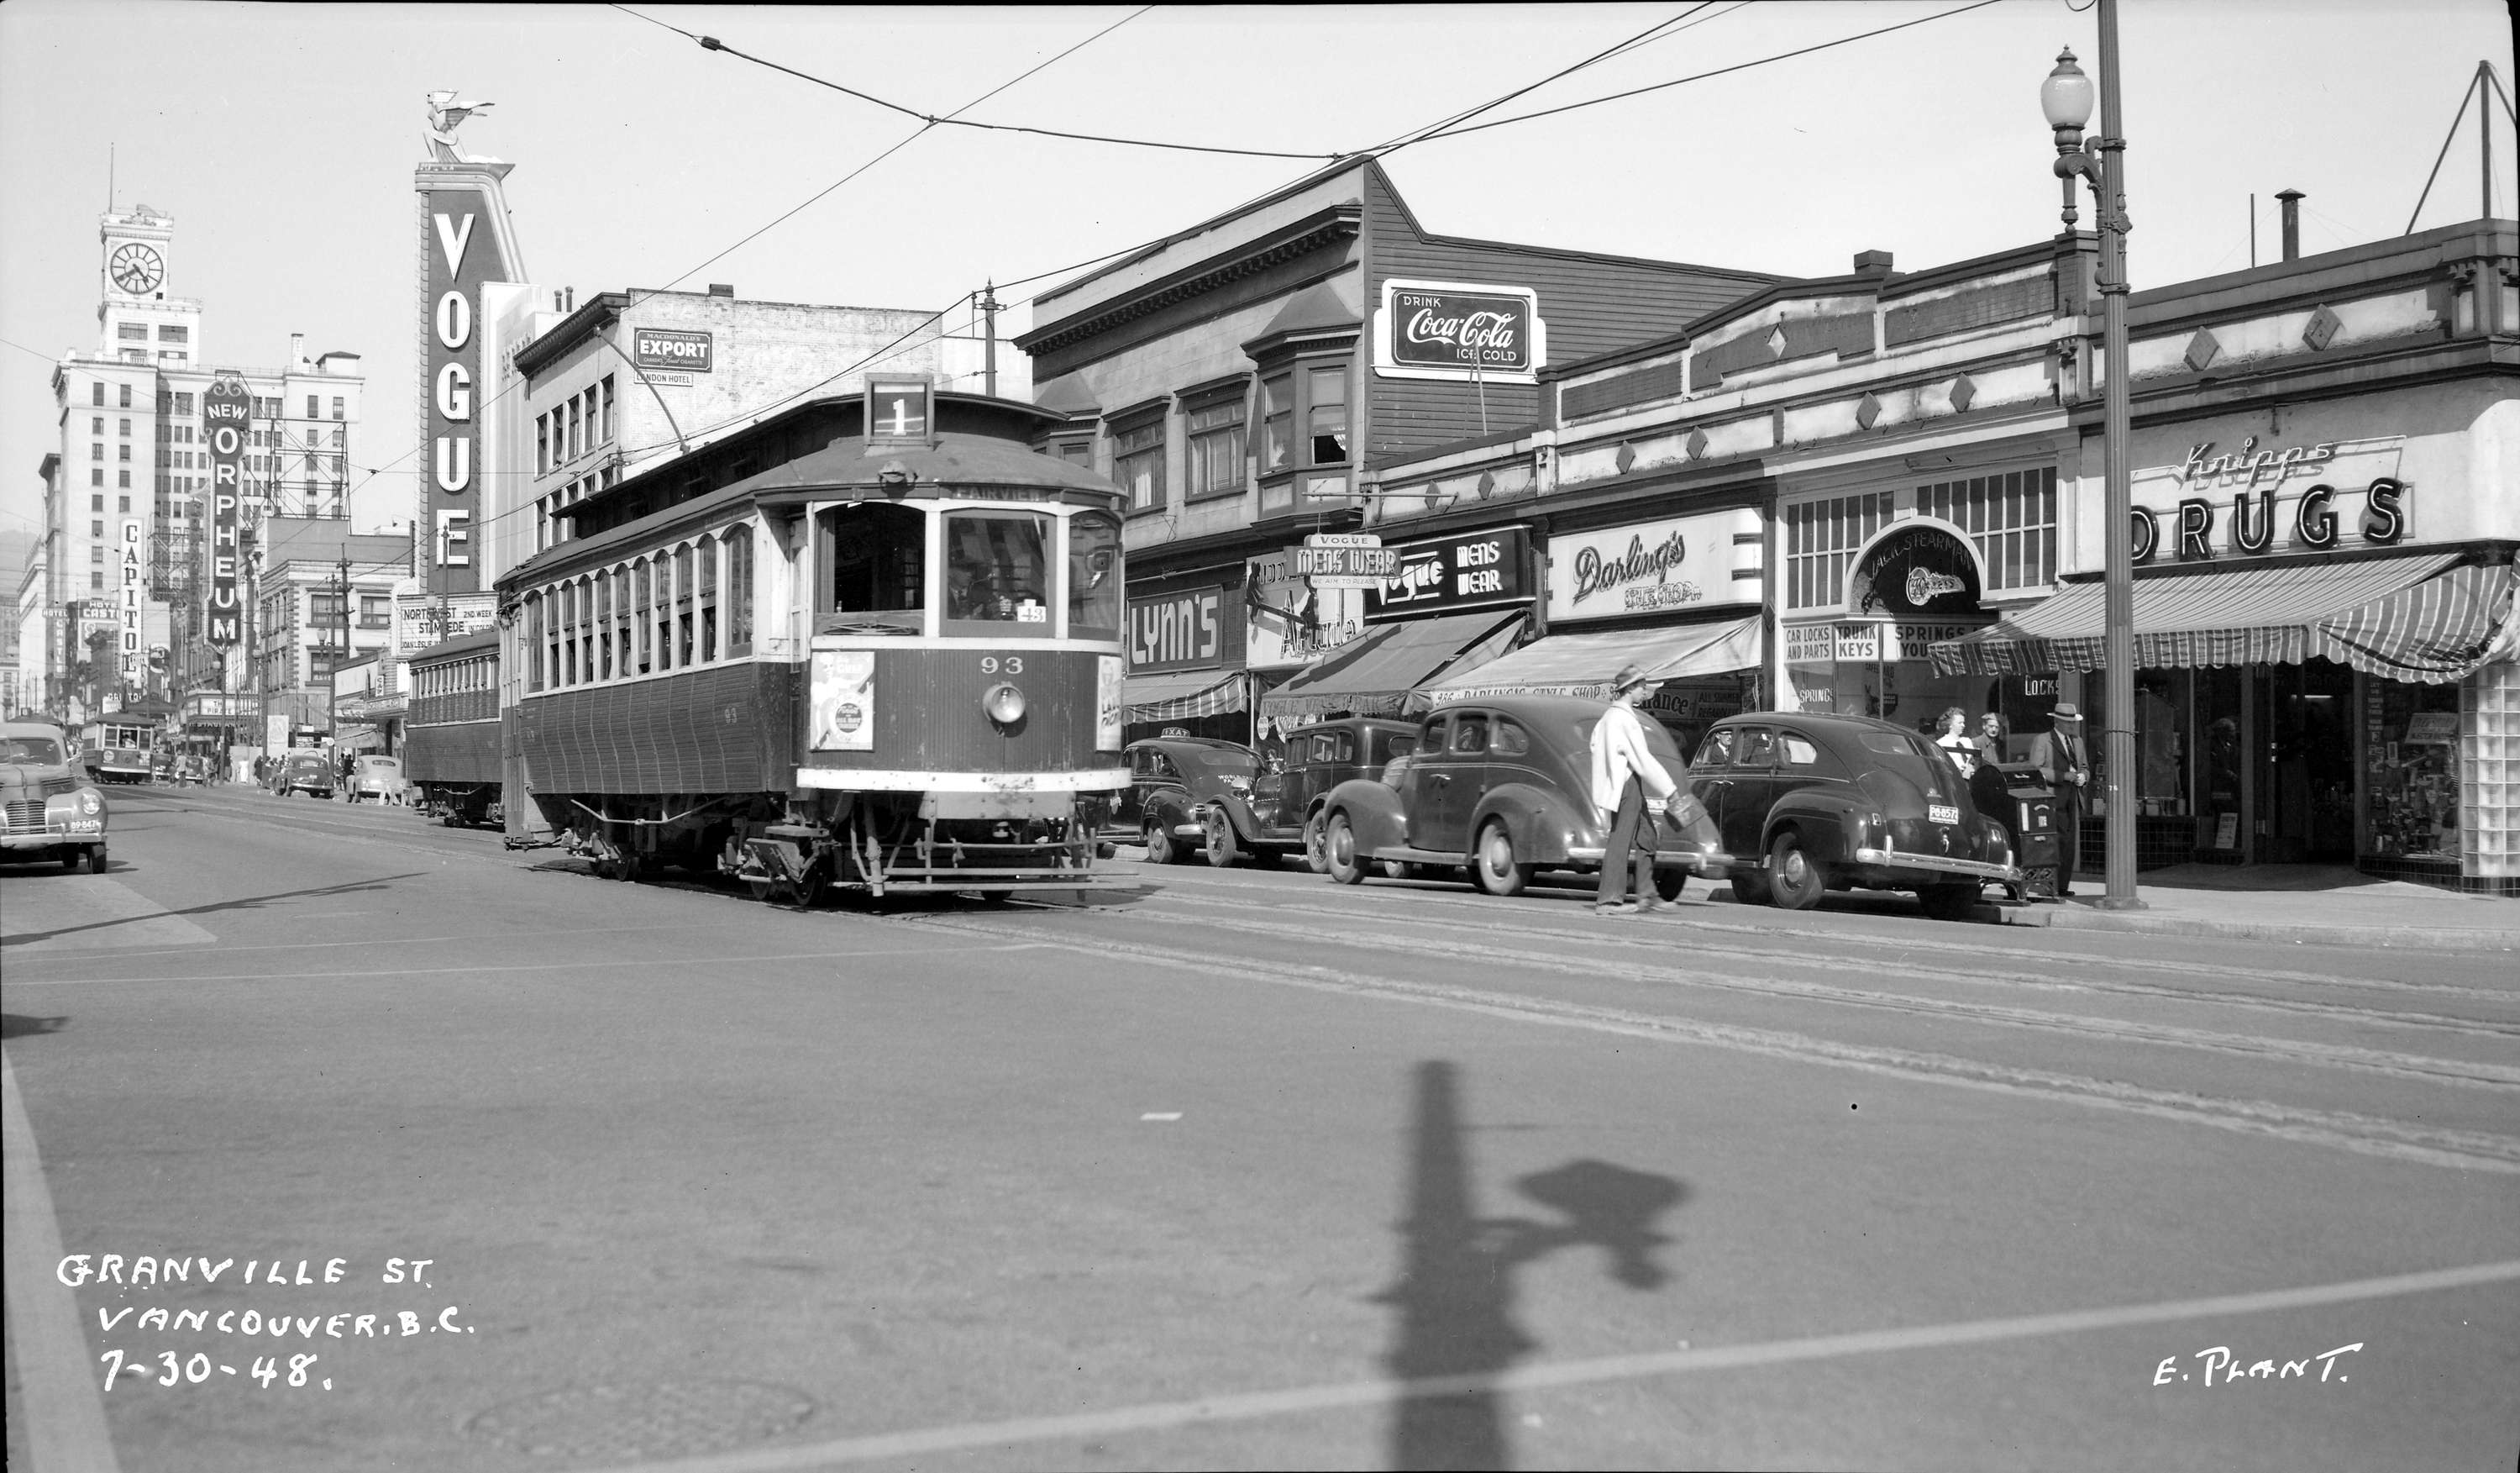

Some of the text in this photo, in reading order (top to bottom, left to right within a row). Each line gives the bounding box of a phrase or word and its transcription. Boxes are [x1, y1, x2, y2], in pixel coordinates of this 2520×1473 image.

[1404, 296, 1441, 308] DRINK
[1407, 308, 1517, 348] Coca-Cola
[639, 339, 708, 358] EXPORT
[1483, 350, 1517, 362] COLD
[433, 213, 475, 566] VOGUE
[669, 376, 690, 384] HOTEL
[207, 403, 248, 420] NEW
[891, 397, 906, 436] 1
[2183, 437, 2338, 486] Knipps
[2132, 476, 2404, 566] DRUGS
[212, 426, 239, 640] ORPHEUM
[1320, 536, 1369, 544] VOGUE
[1349, 550, 1397, 576] WEAR
[1457, 542, 1500, 565] MENS
[1573, 530, 1685, 607] Darling's
[1457, 573, 1504, 595] WEAR
[123, 524, 139, 672] CAPITOL
[477, 610, 492, 618] WEEK
[1131, 594, 1218, 665] LYNN'S
[1787, 627, 1830, 643] CAR LOCKS
[1837, 625, 1877, 640] TRUNK
[1895, 626, 1964, 640] SPRINGS
[1788, 643, 1830, 660] AND PARTS
[1839, 643, 1873, 657] KEYS
[981, 656, 1023, 675] 93
[1572, 684, 1601, 699] SHOP
[1799, 687, 1833, 703] SPRINGS
[2025, 677, 2061, 697] LOCKS
